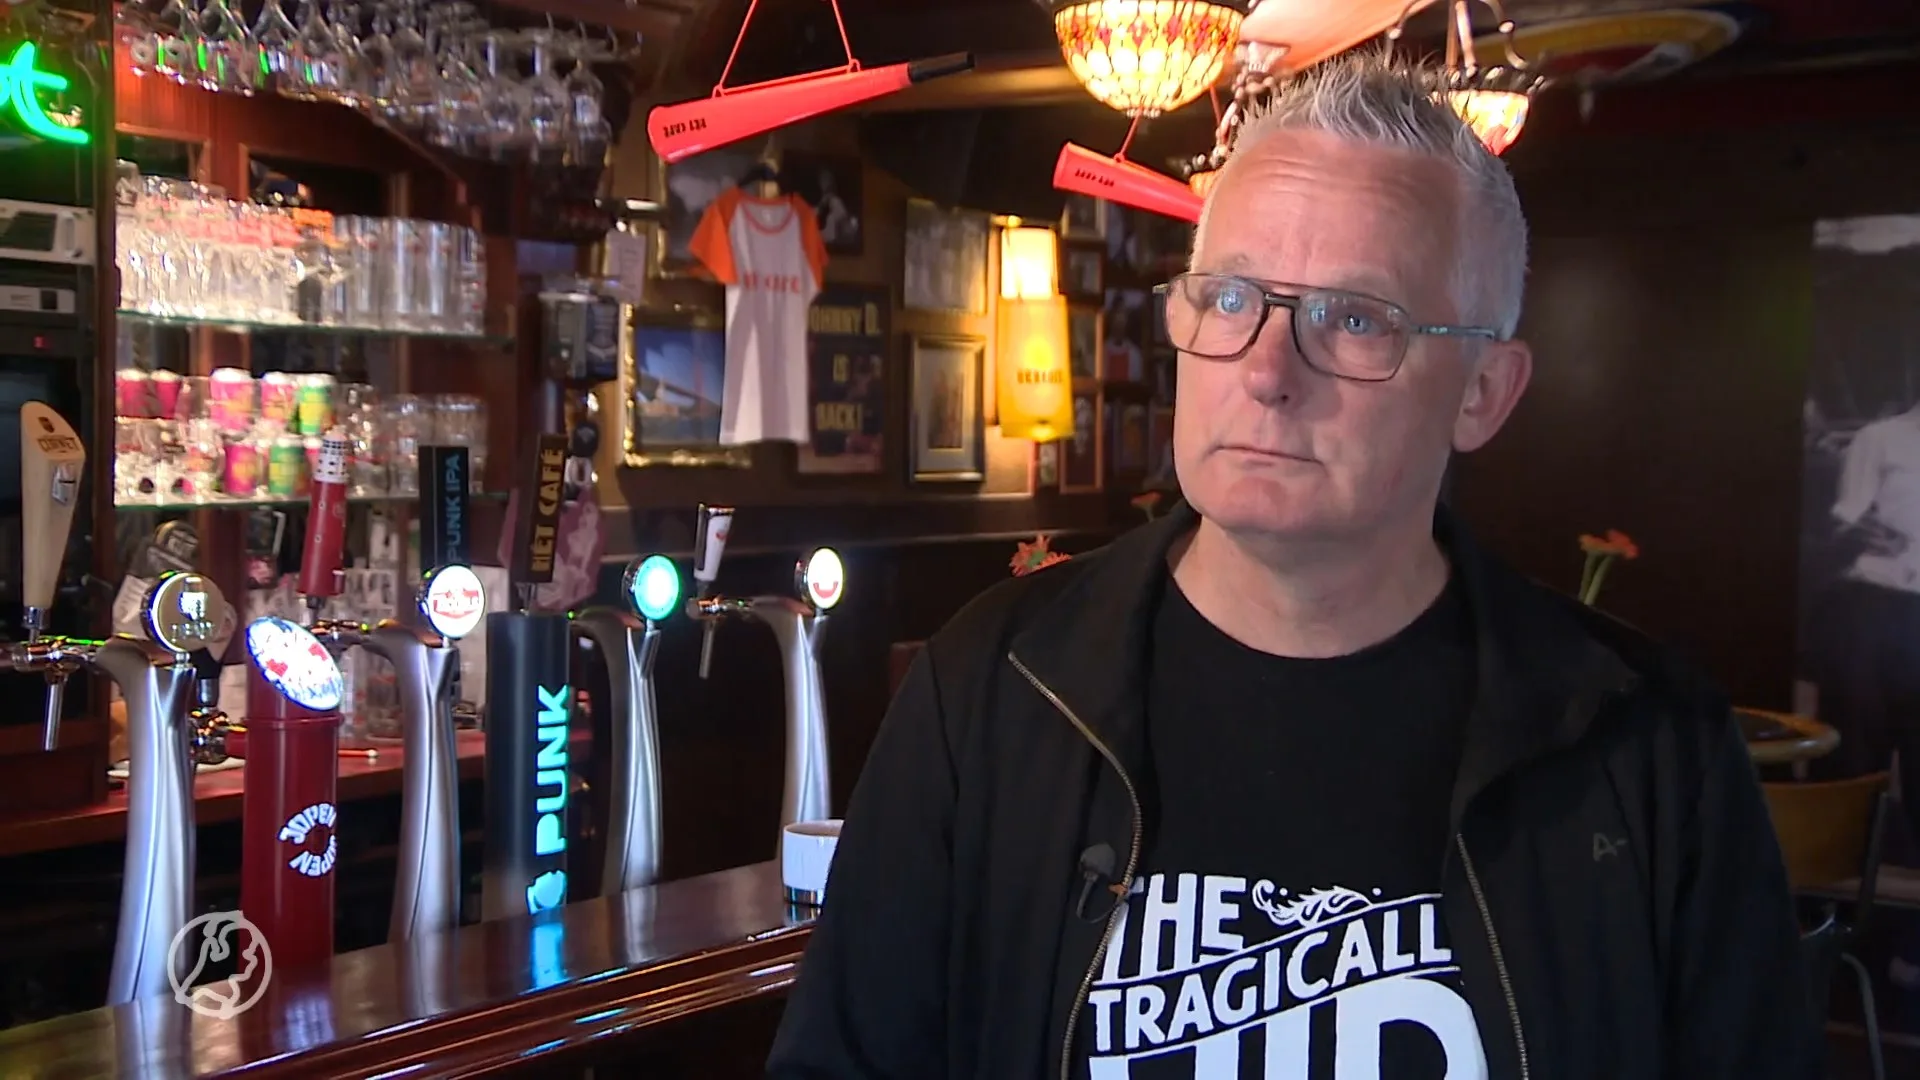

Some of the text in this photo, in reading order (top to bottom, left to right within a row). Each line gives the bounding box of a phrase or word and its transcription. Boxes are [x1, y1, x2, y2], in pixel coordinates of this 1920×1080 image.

[445, 453, 462, 563] PUNK IPA
[279, 803, 337, 844] JOPEN
[536, 685, 569, 855] PUNK
[1103, 873, 1248, 983] THE
